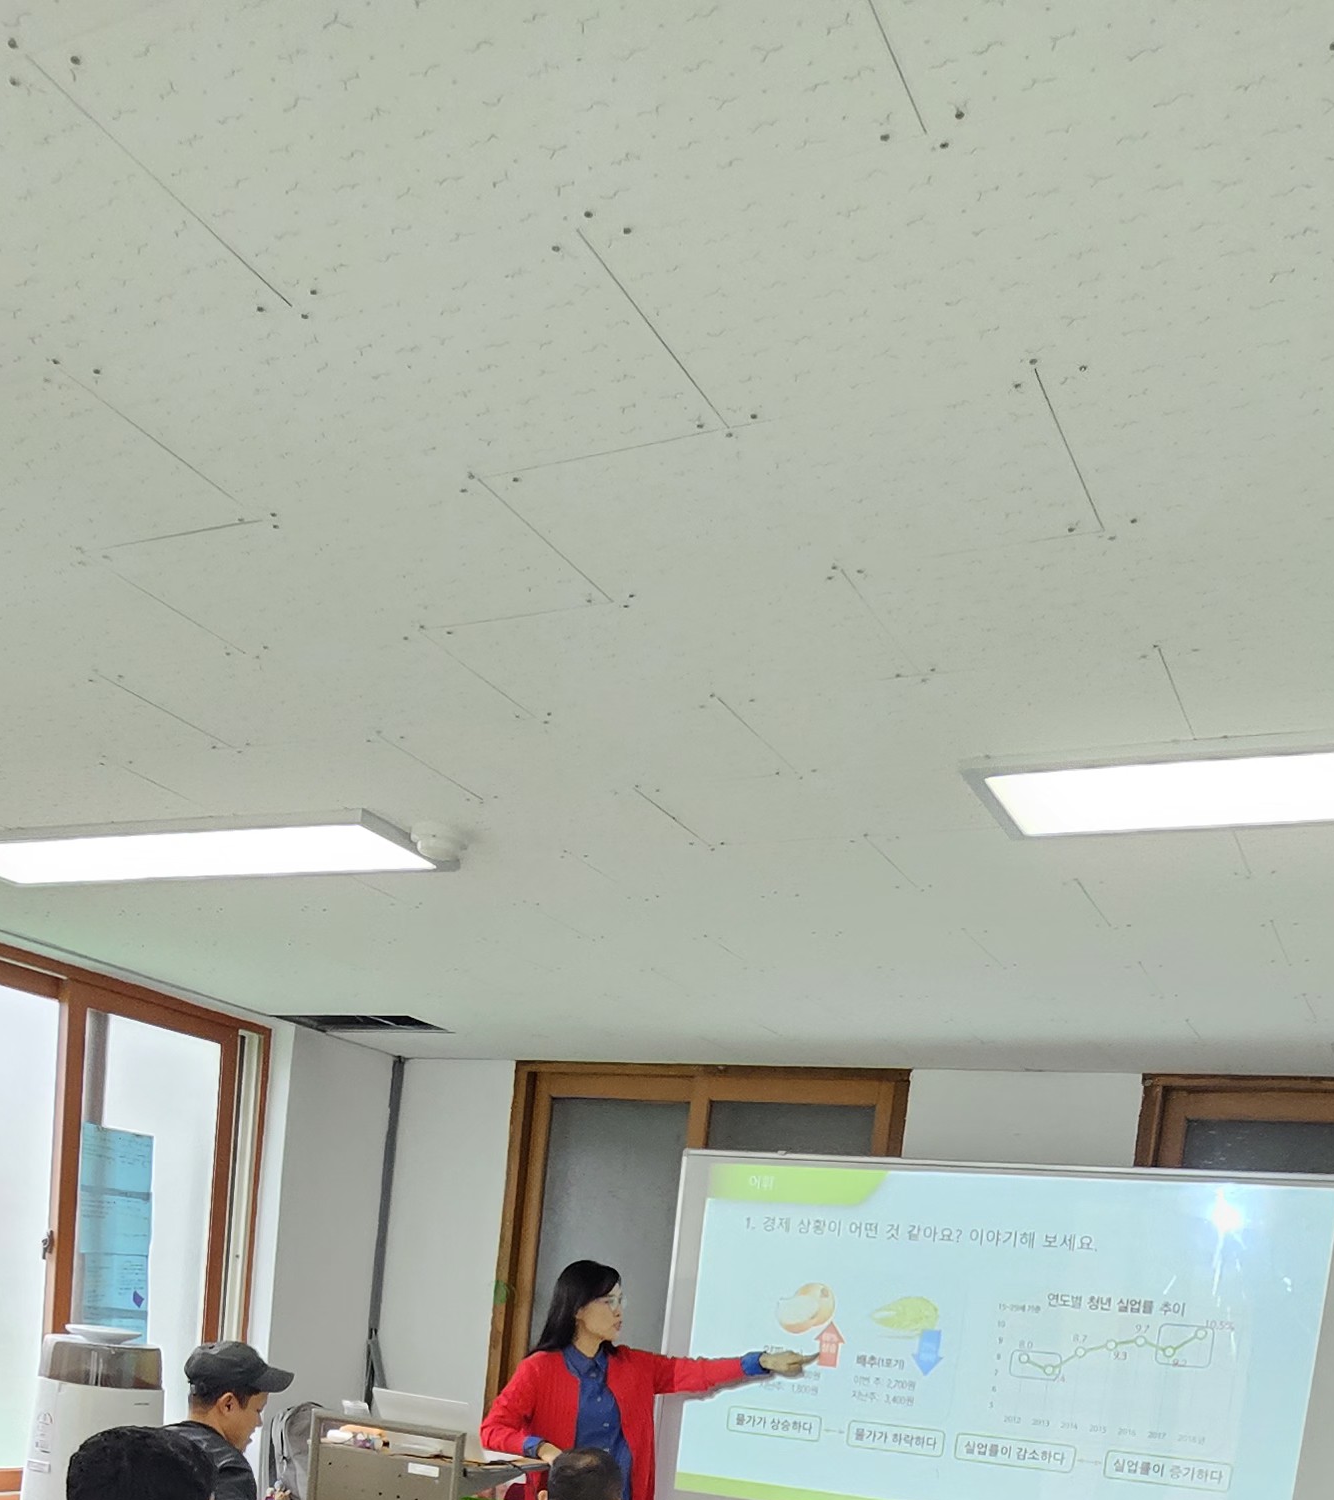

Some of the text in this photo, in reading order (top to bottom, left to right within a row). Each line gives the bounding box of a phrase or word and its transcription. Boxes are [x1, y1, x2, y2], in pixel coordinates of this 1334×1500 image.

[745, 1216, 1098, 1252] 1. 경제 상황이 어떤 것 같아요? 이야기해 보세요.
[1047, 1293, 1186, 1316] 연도별 청년 실업률 추이
[856, 1355, 905, 1370] 배추(1포기)
[1113, 1351, 1127, 1361] 9.3
[853, 1375, 873, 1387] 이번
[886, 1378, 916, 1391] 2,700원
[884, 1393, 914, 1407] 3,400원
[736, 1413, 813, 1434] 물가가 상승하다
[1089, 1424, 1107, 1434] 2015
[1147, 1430, 1166, 1440] 2017
[855, 1428, 937, 1449] 물가가 하락하다
[964, 1440, 1065, 1466] 실업률이 감소하다
[1113, 1458, 1165, 1477] 실업률이
